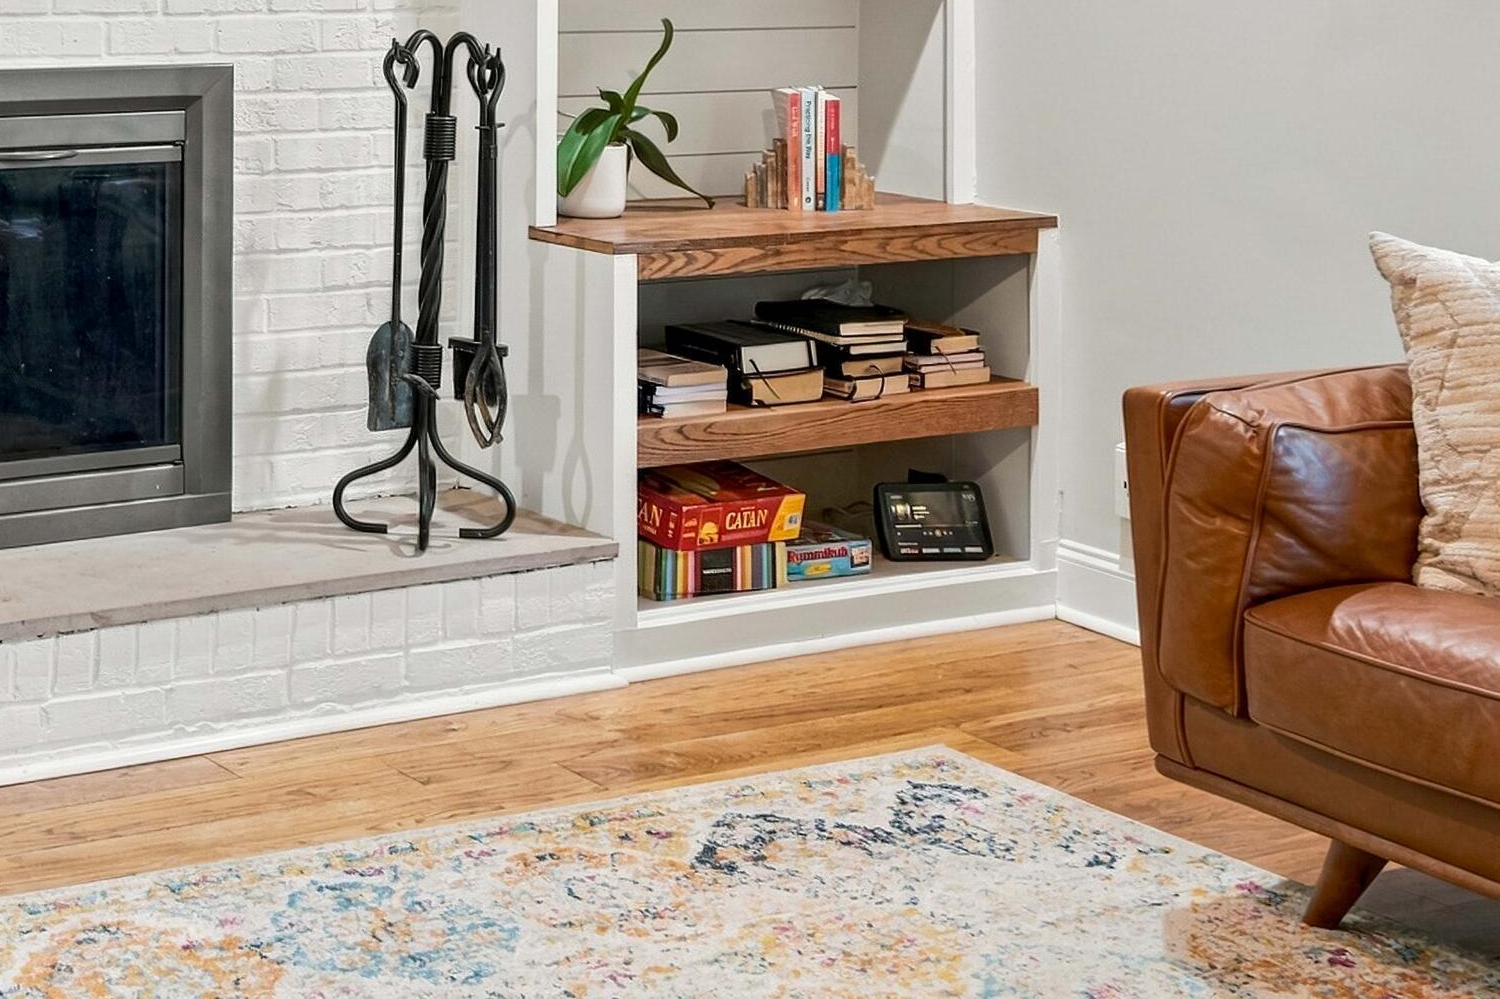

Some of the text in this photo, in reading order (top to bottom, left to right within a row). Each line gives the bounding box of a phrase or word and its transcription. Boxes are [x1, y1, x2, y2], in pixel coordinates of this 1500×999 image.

[638, 500, 663, 528] AN
[725, 509, 769, 530] CATAN
[787, 546, 848, 564] Rummikub
